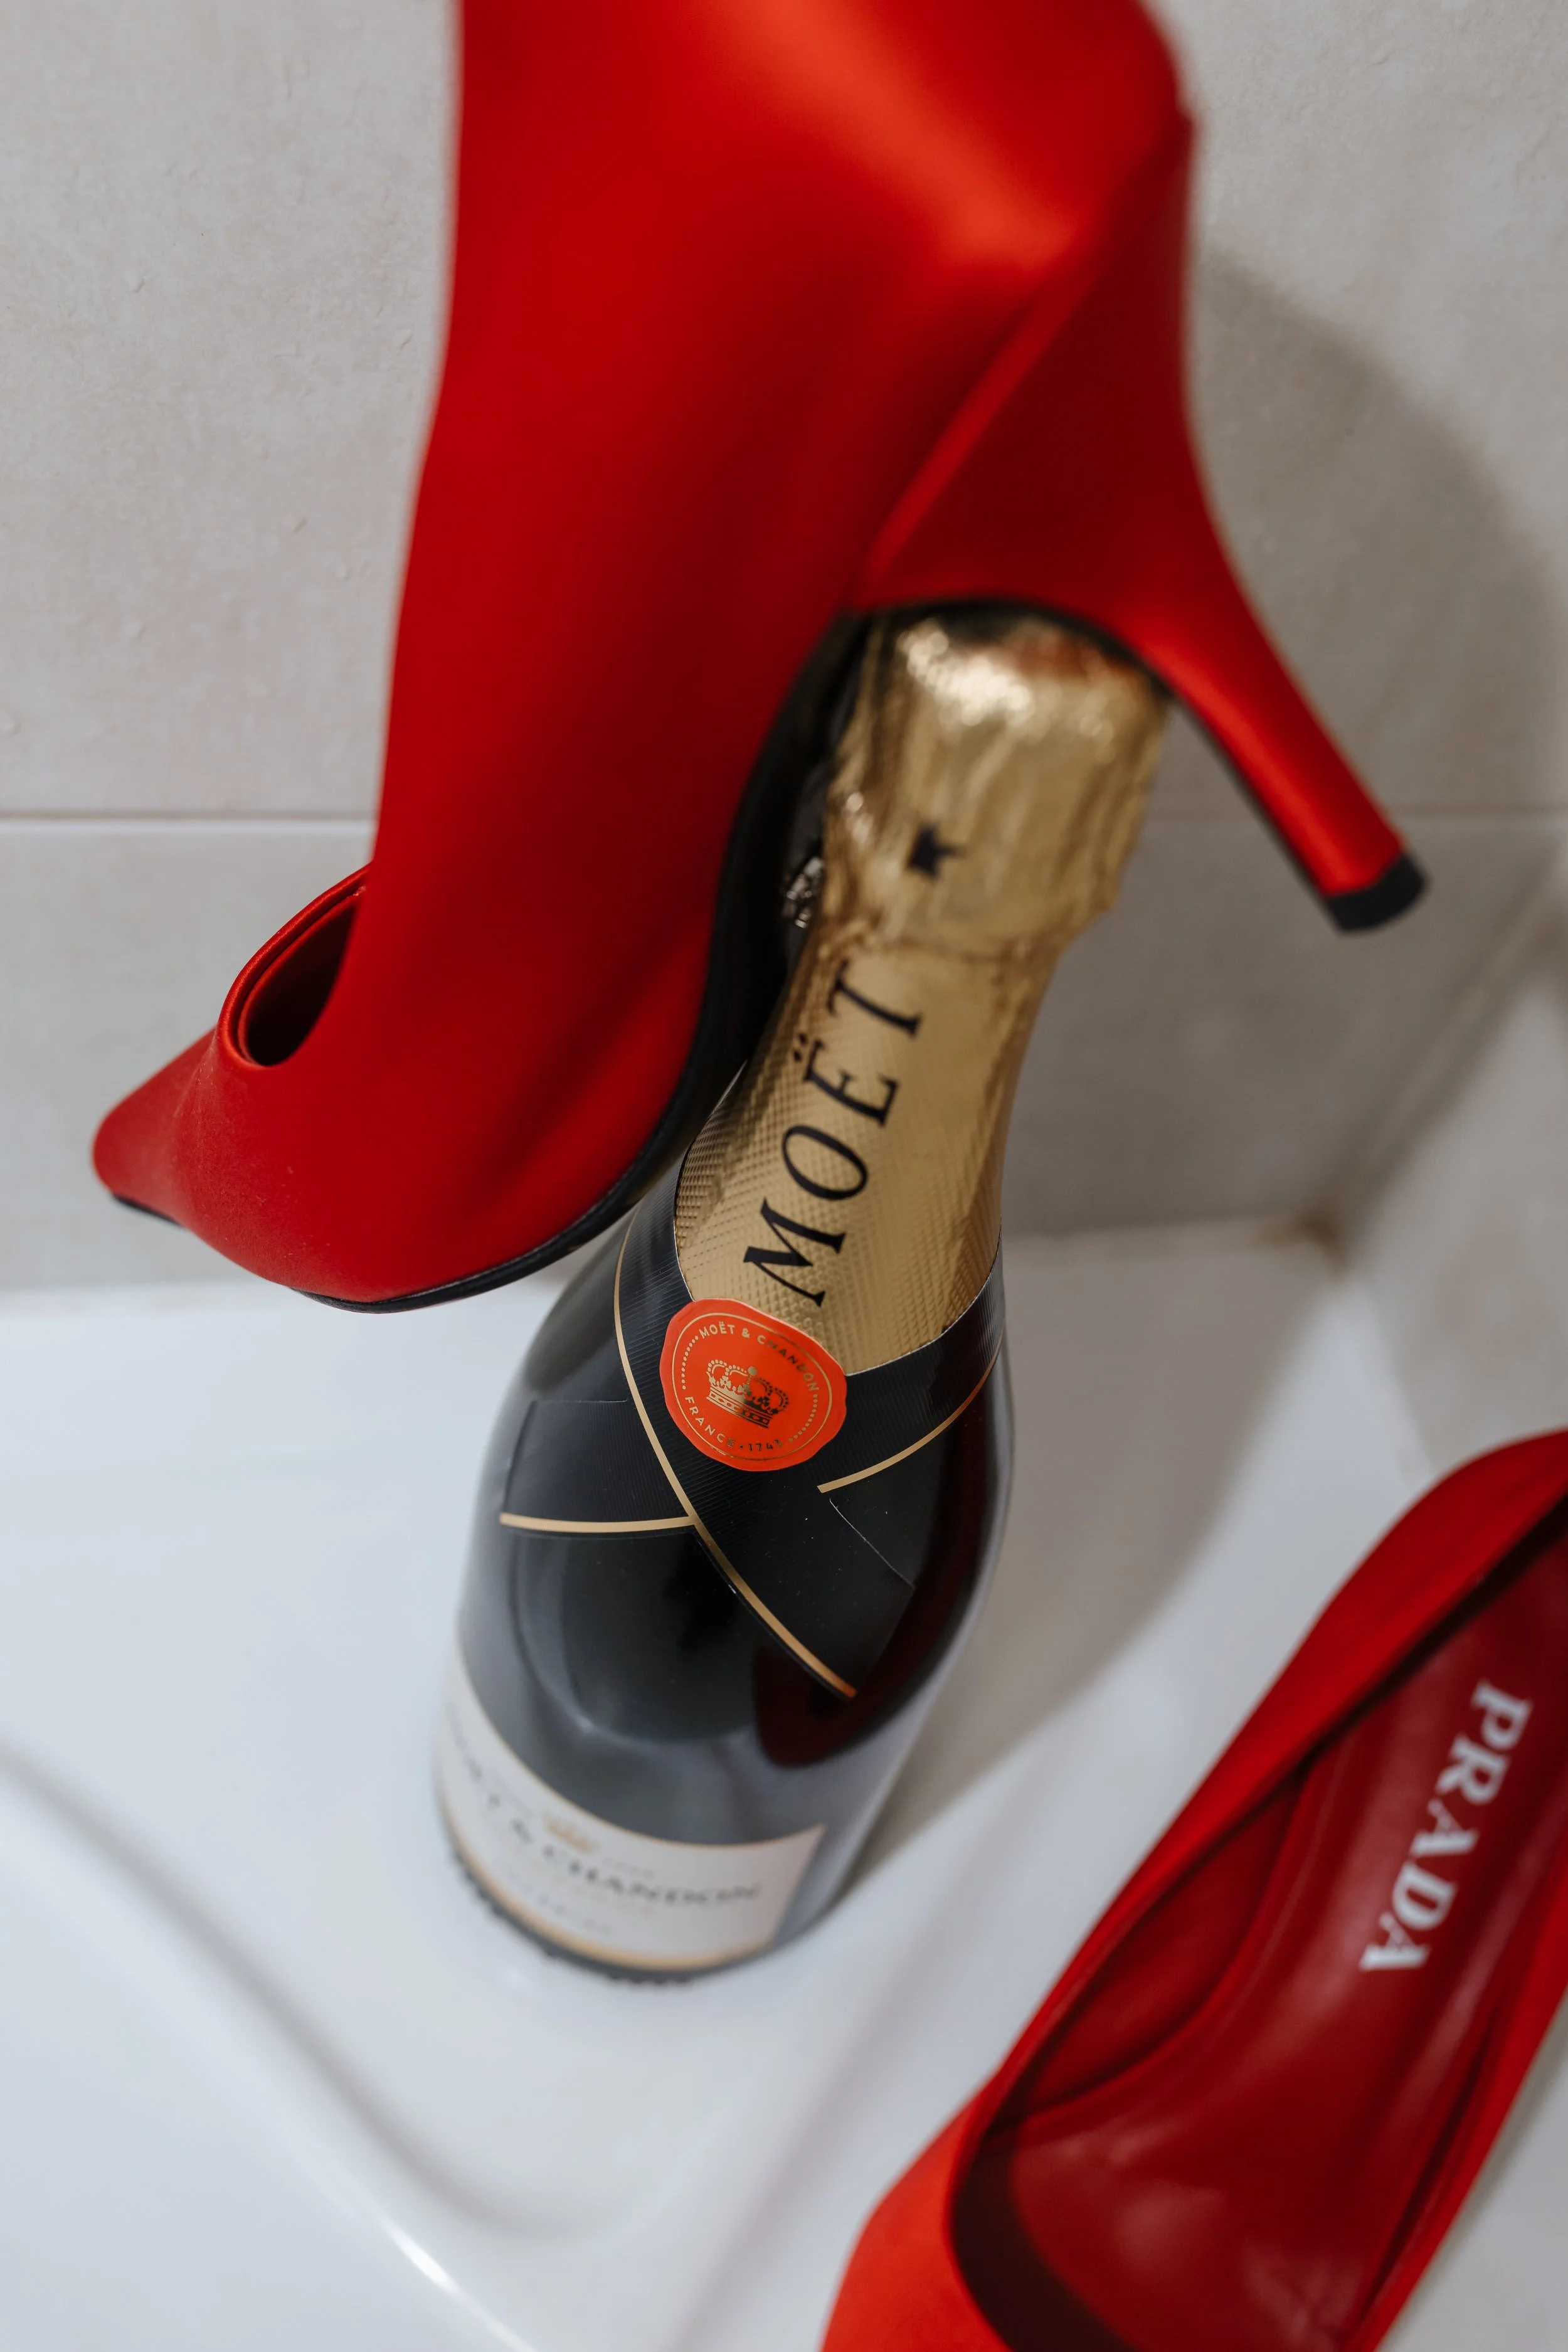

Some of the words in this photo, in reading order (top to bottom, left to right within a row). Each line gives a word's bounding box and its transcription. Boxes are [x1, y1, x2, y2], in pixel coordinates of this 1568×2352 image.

[743, 958, 923, 1308] MOËT
[685, 1396, 736, 1448] FRANCE
[698, 1321, 735, 1340] MOËT
[741, 1327, 750, 1338] &
[756, 1334, 819, 1392] CHANDON
[1359, 1678, 1534, 1971] PRADA
